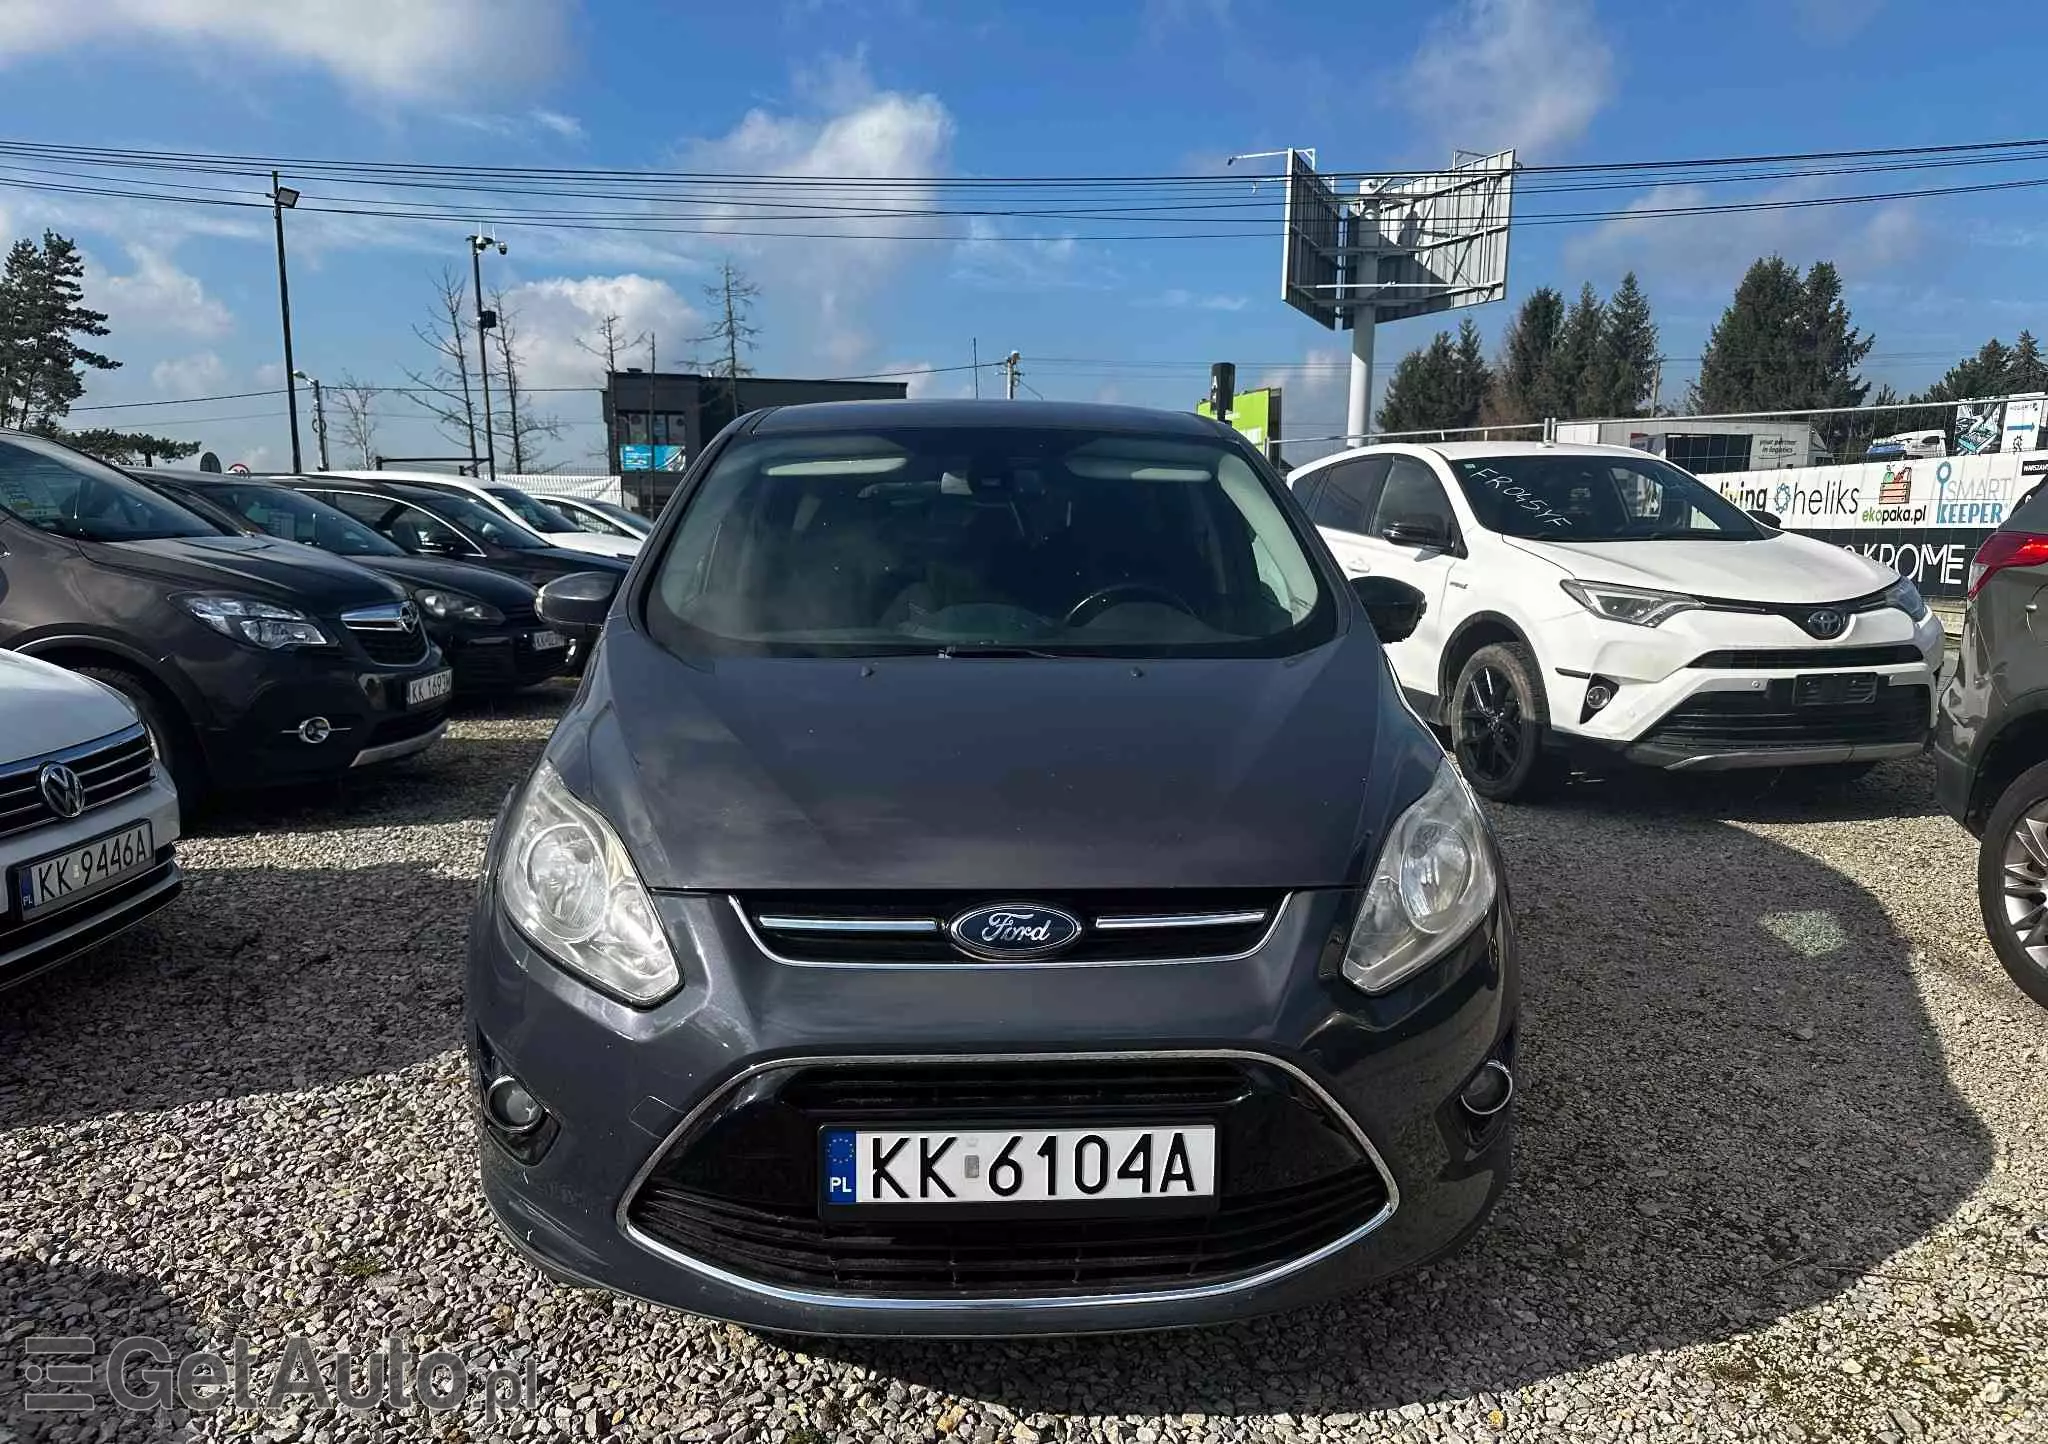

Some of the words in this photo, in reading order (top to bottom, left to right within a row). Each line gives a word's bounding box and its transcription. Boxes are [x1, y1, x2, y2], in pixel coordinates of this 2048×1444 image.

[1791, 479, 1860, 515] heliks
[1947, 478, 2011, 501] SMART
[1862, 505, 1927, 525] ekopaka.pl
[1936, 503, 2003, 523] KEEPER
[38, 857, 73, 902] KK
[80, 829, 146, 885] 9446A
[981, 912, 1052, 941] Ford
[829, 1176, 853, 1193] PL
[872, 1135, 958, 1199] KK
[988, 1132, 1197, 1197] 6104A
